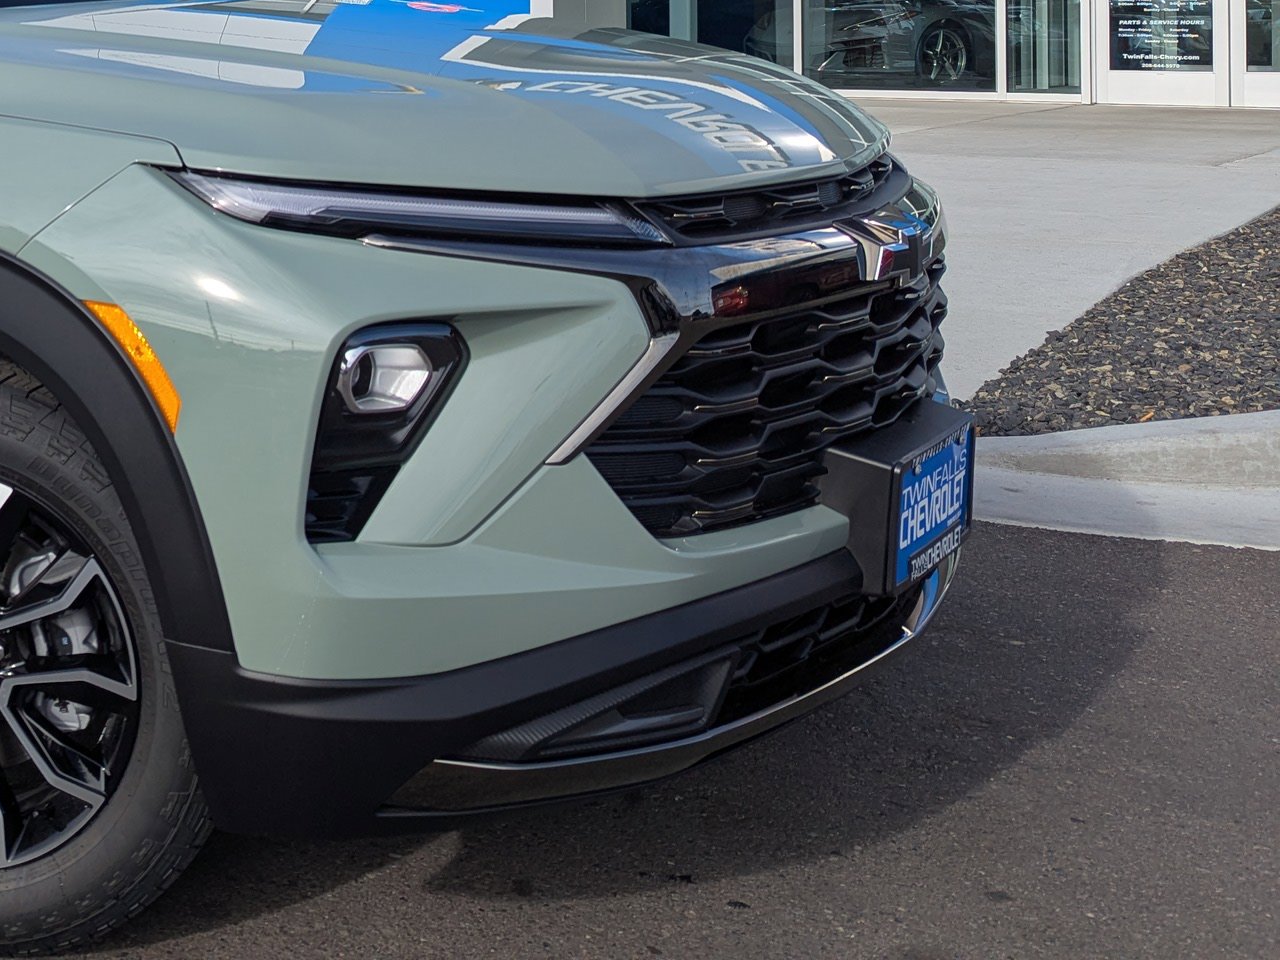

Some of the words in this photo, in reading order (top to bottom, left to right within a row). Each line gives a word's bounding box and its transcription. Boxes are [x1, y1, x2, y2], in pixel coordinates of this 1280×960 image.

[1122, 53, 1200, 61] TwinFalls-Chevy.com
[902, 448, 967, 506] TWINFALLS
[899, 470, 966, 550] CHEVROLET
[911, 551, 928, 572] TWIN
[927, 525, 962, 570] CHEVROLET
